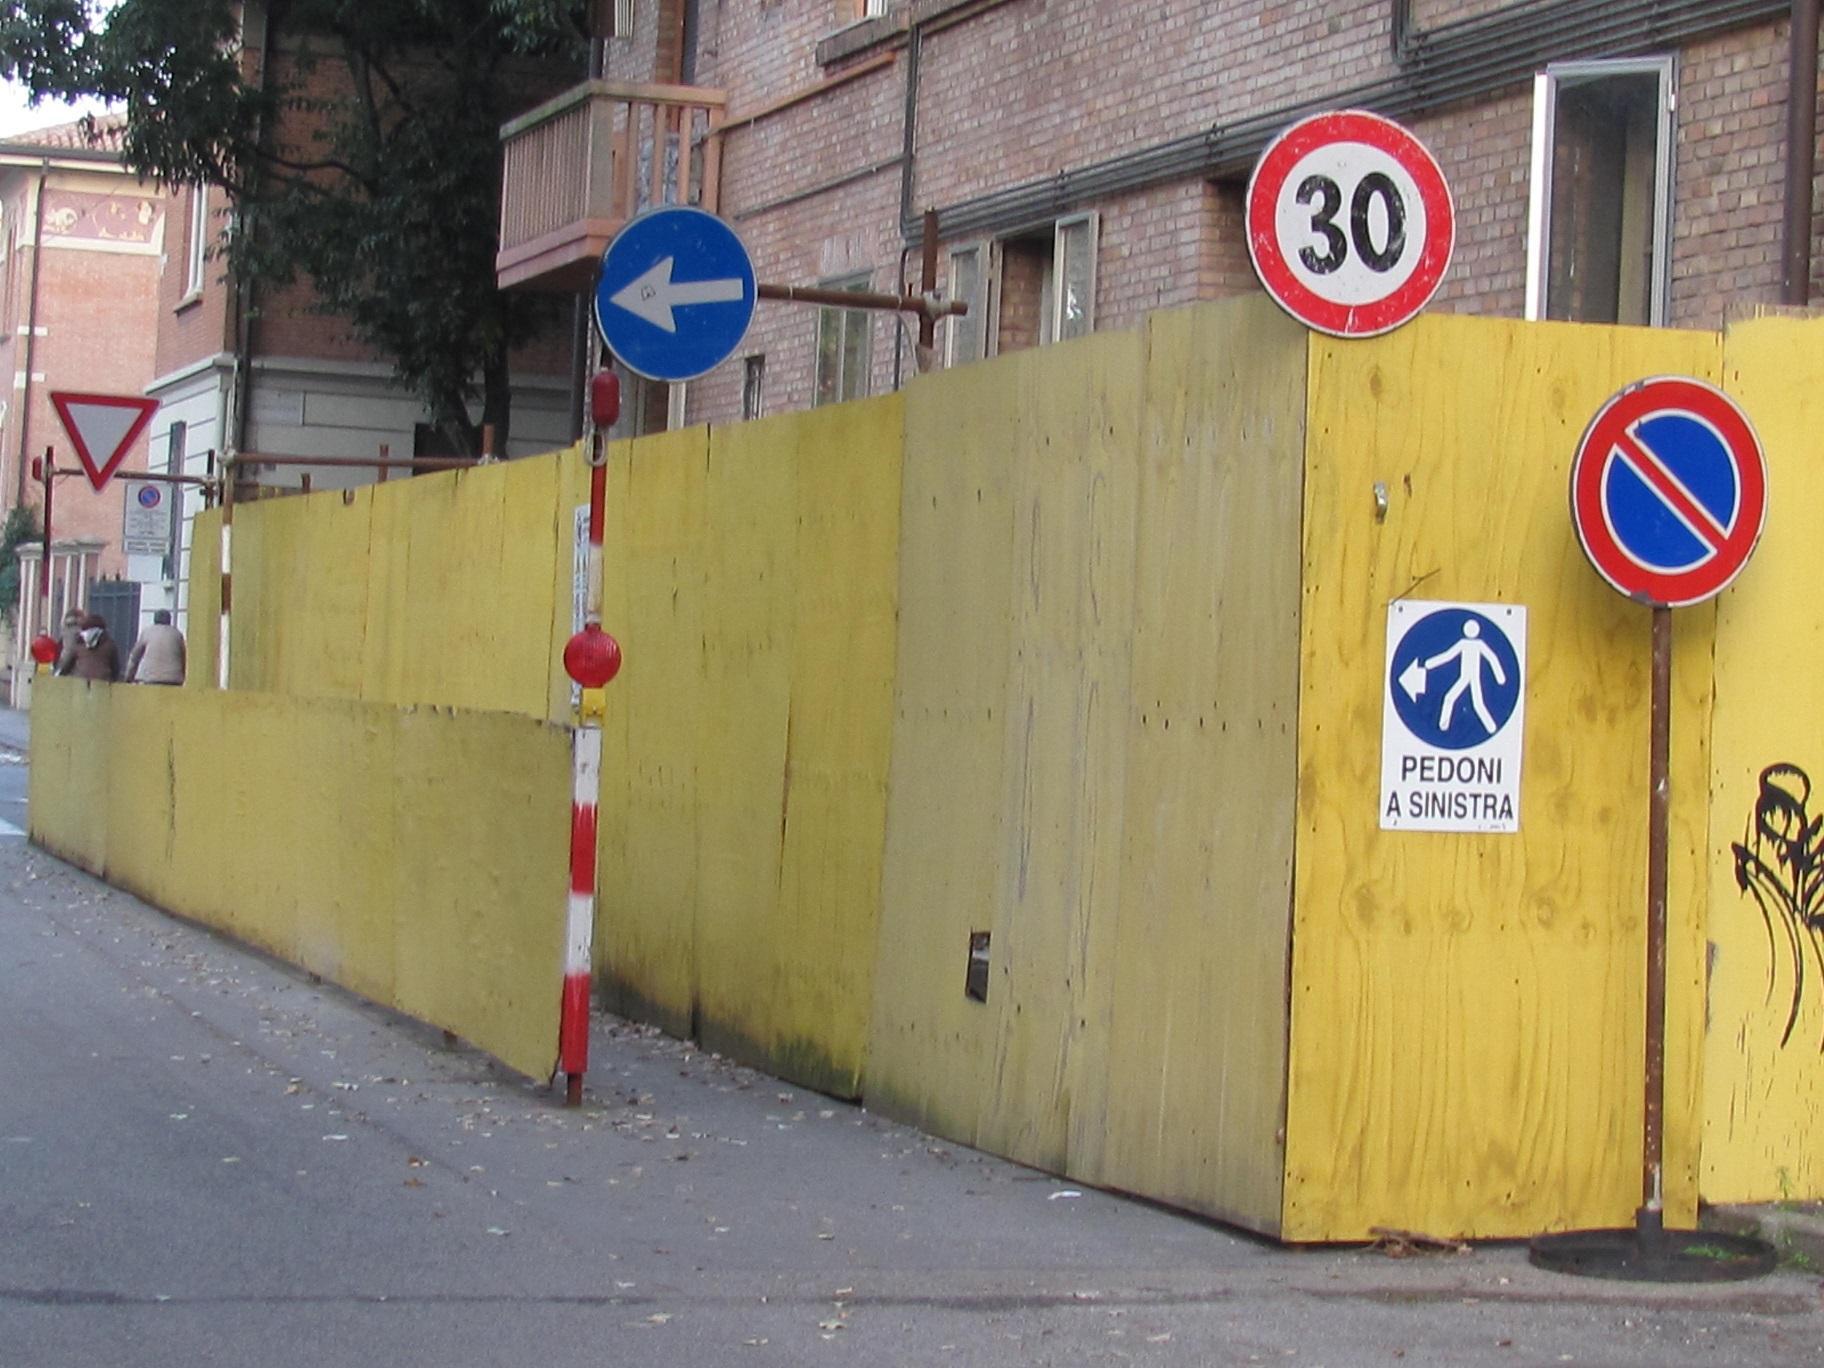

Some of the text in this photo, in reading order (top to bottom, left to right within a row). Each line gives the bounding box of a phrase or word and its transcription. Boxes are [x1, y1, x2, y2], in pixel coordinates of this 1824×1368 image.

[1296, 171, 1407, 275] 30
[1401, 755, 1502, 785] PEDONI
[1386, 791, 1513, 820] A SINISTRA
